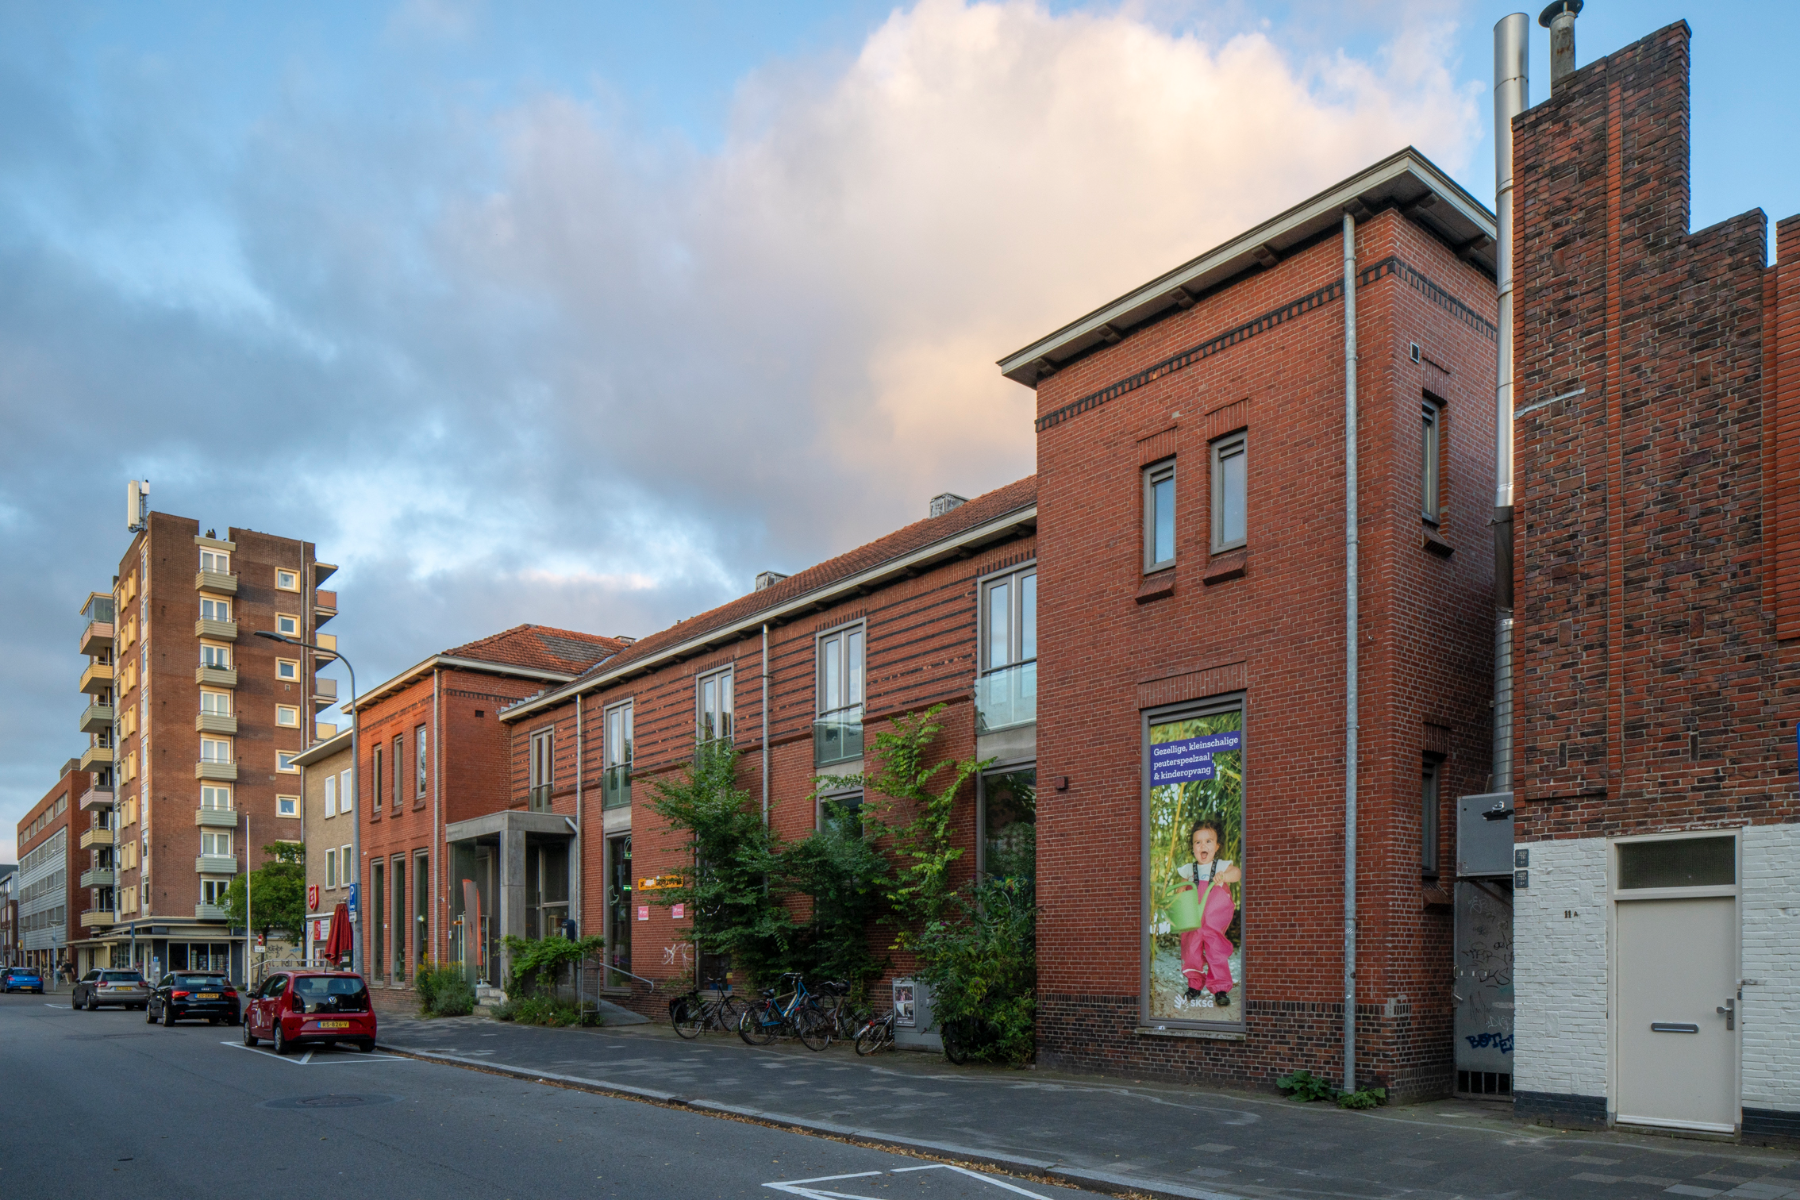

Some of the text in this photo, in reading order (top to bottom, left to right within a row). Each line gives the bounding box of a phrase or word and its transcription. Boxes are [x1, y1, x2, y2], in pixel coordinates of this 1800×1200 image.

[1154, 737, 1238, 756] Gezellige, kleinschalige
[1154, 753, 1210, 770] peuterspeelzaal
[1154, 767, 1211, 780] & kinderopvang
[1190, 999, 1213, 1008] SKSG
